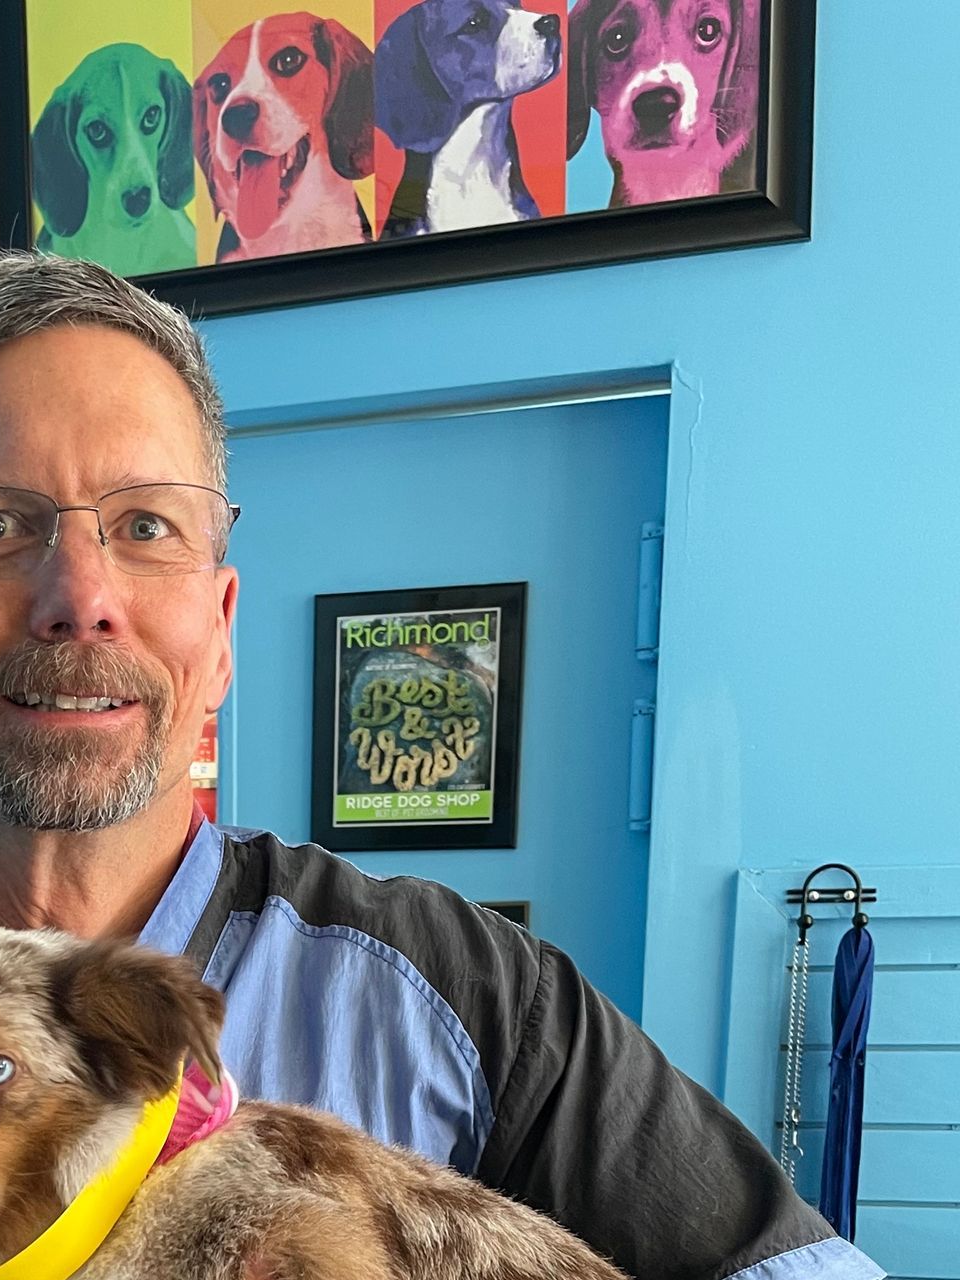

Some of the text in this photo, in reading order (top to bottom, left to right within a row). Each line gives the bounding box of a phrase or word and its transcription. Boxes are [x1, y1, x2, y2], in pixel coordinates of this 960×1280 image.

[346, 613, 490, 649] Richmond
[351, 669, 477, 728] Best
[349, 717, 481, 792] Worst
[346, 793, 481, 810] RIDGE DOG SHOP
